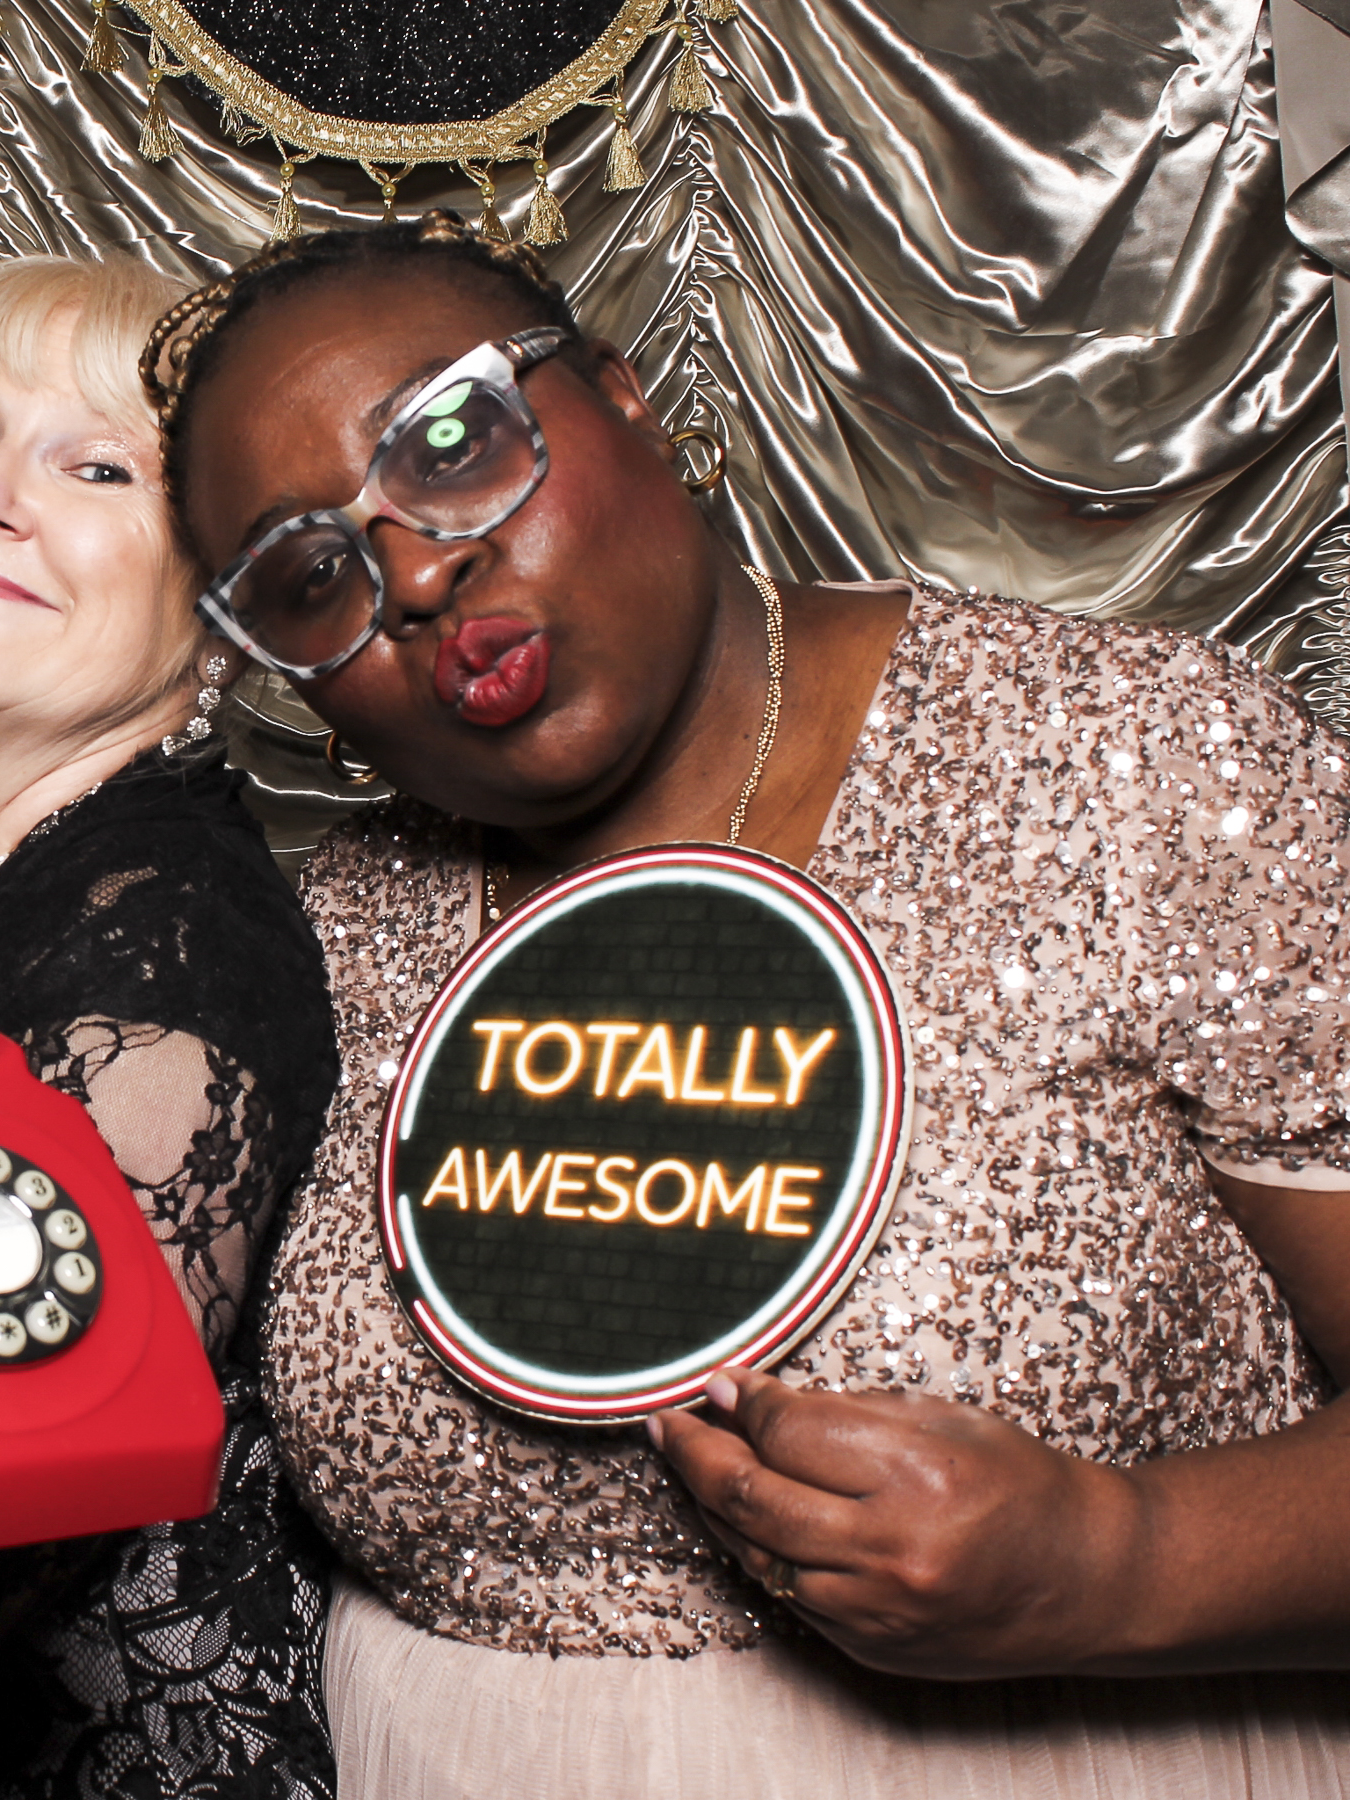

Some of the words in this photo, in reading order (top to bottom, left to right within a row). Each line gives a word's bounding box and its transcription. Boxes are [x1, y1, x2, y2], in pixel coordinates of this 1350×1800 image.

[472, 1020, 837, 1106] TOTALLY
[32, 1177, 47, 1196] 3
[420, 1147, 822, 1236] AWESOME
[62, 1215, 78, 1235] 2
[74, 1258, 86, 1278] 1
